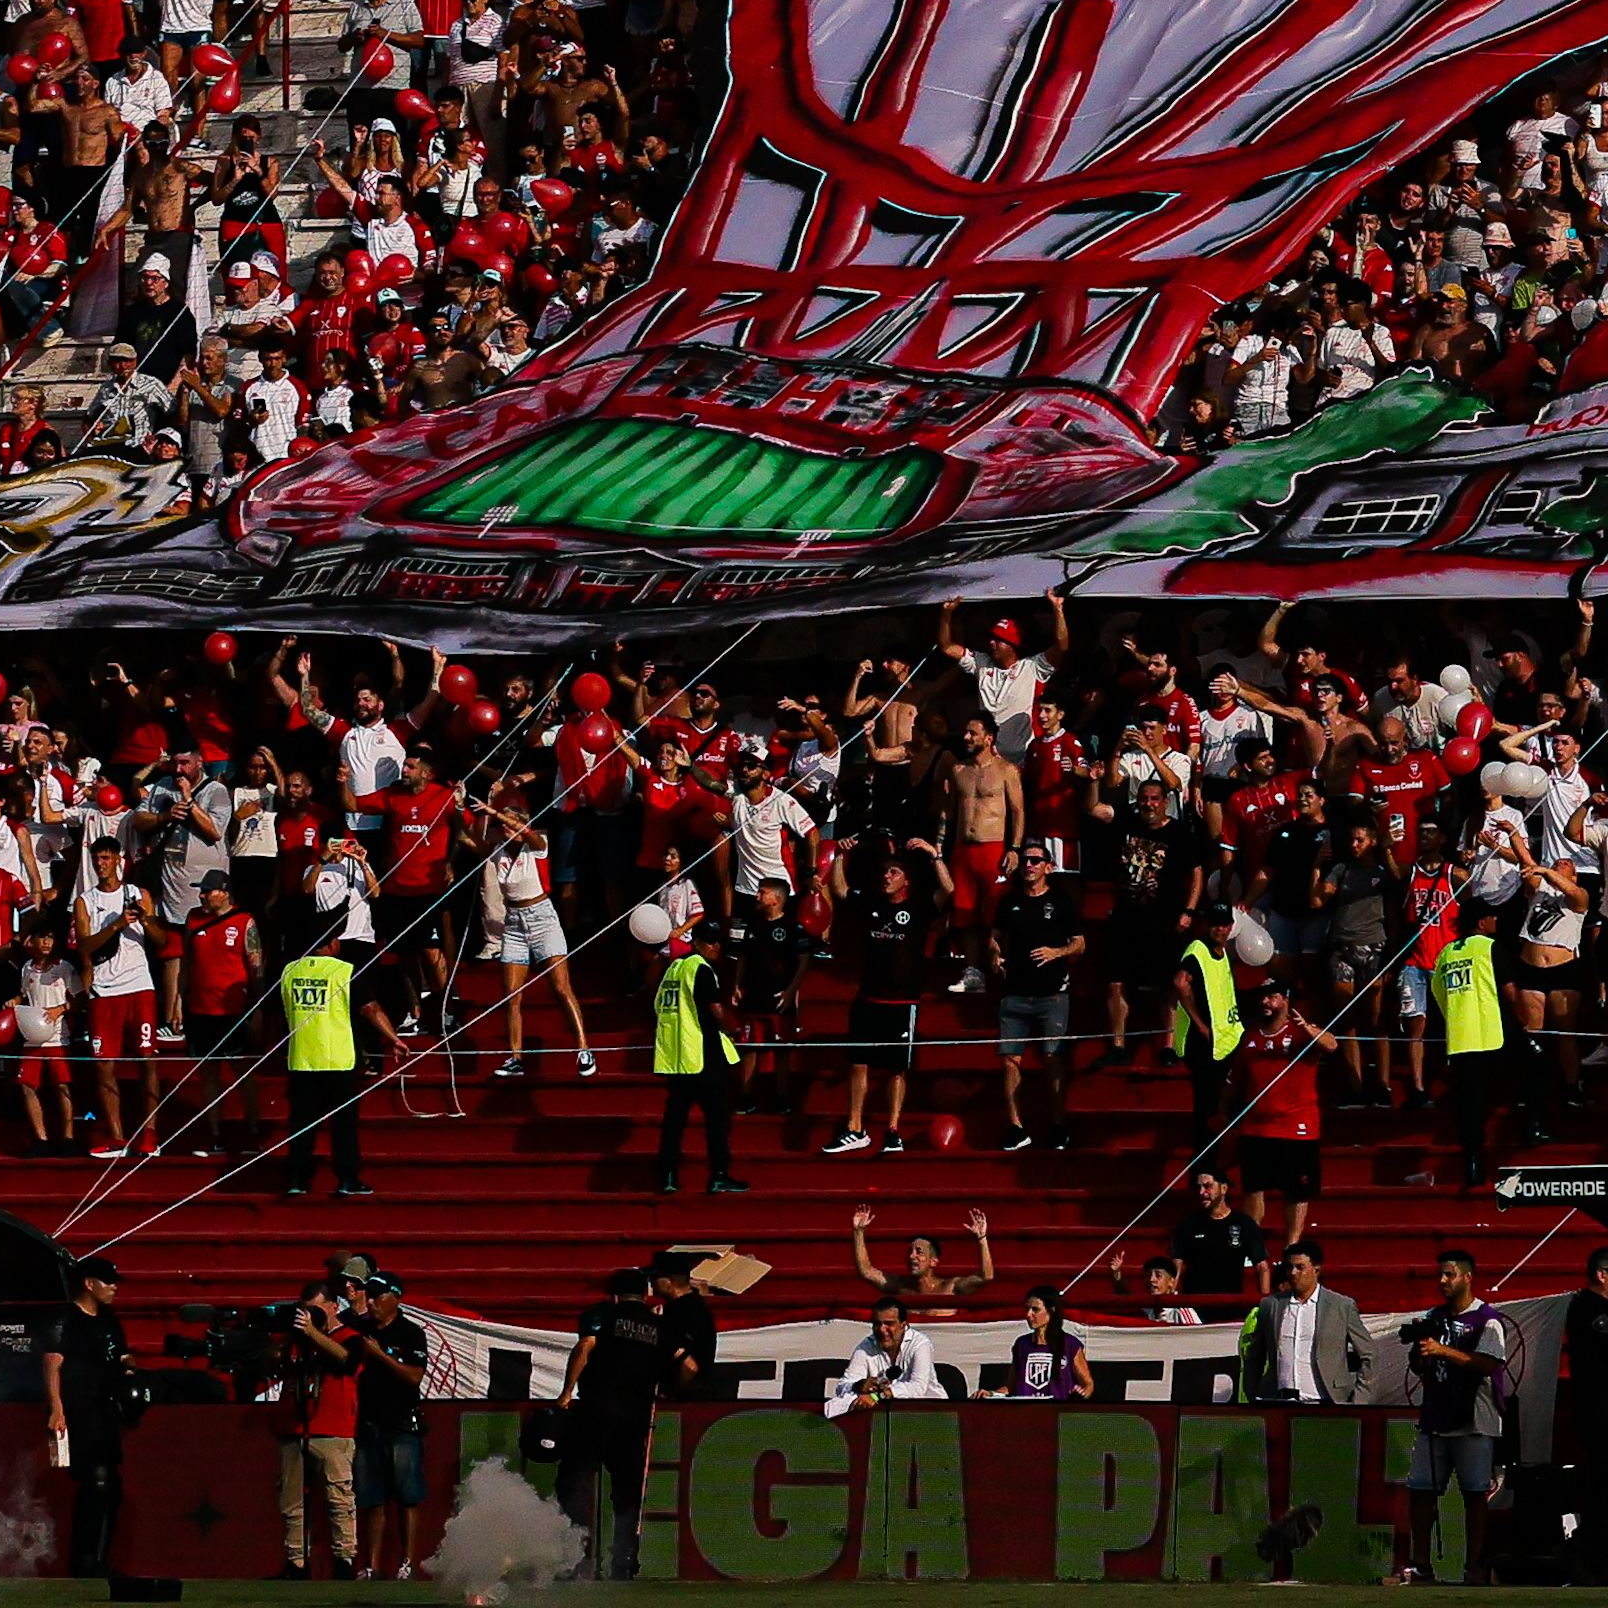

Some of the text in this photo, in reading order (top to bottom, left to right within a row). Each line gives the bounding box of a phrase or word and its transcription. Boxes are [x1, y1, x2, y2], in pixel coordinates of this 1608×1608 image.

[1399, 780, 1423, 790] Ciudad
[141, 1022, 152, 1041] 9
[1512, 1179, 1606, 1198] POWERADE
